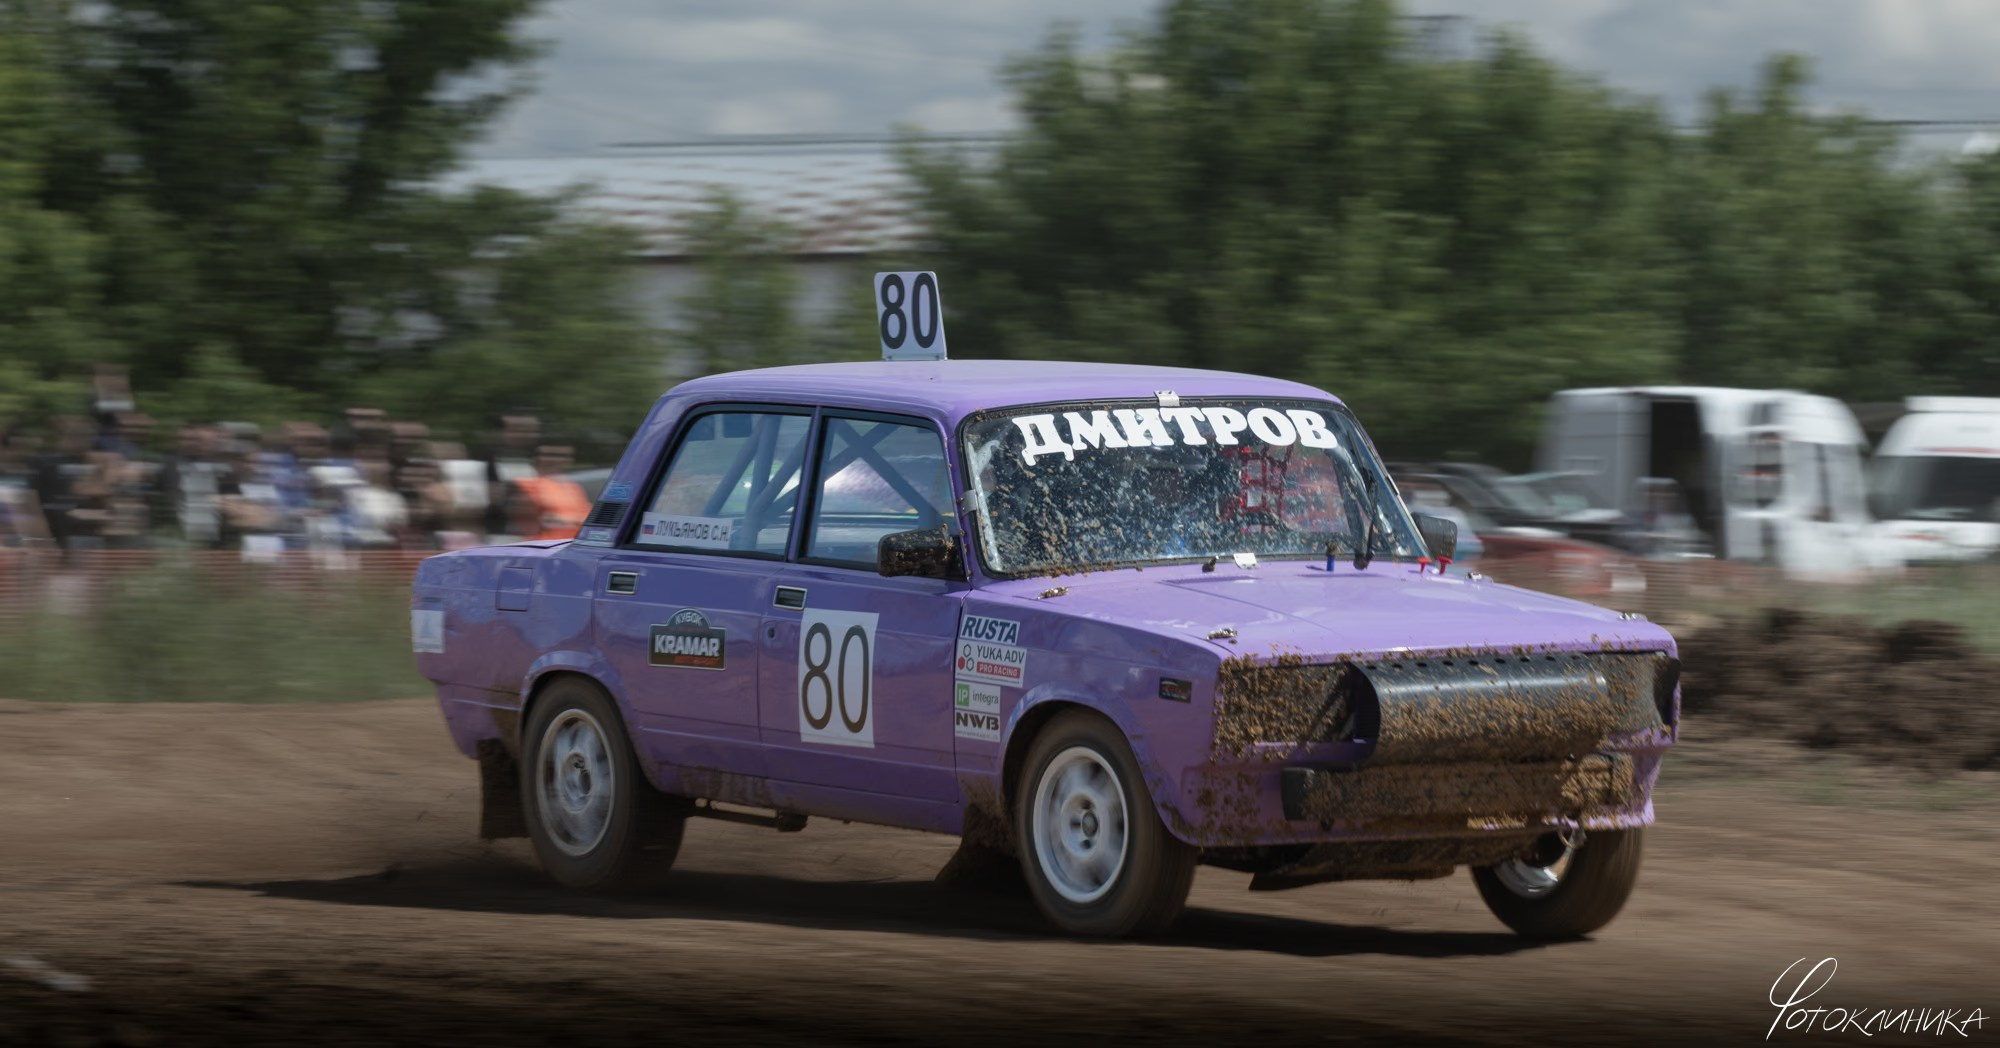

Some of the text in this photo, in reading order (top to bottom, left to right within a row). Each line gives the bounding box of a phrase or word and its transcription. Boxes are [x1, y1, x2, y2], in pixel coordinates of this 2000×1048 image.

[881, 273, 938, 349] 80
[1012, 407, 1338, 466] ДМИТРОВ
[962, 616, 1017, 643] RUSTA
[655, 634, 720, 657] KRAMAR
[977, 644, 1025, 664] YUKA ADV
[802, 622, 869, 733] 80
[979, 663, 1018, 677] PRO RACING
[958, 687, 999, 706] IP integra
[956, 711, 999, 731] NWB
